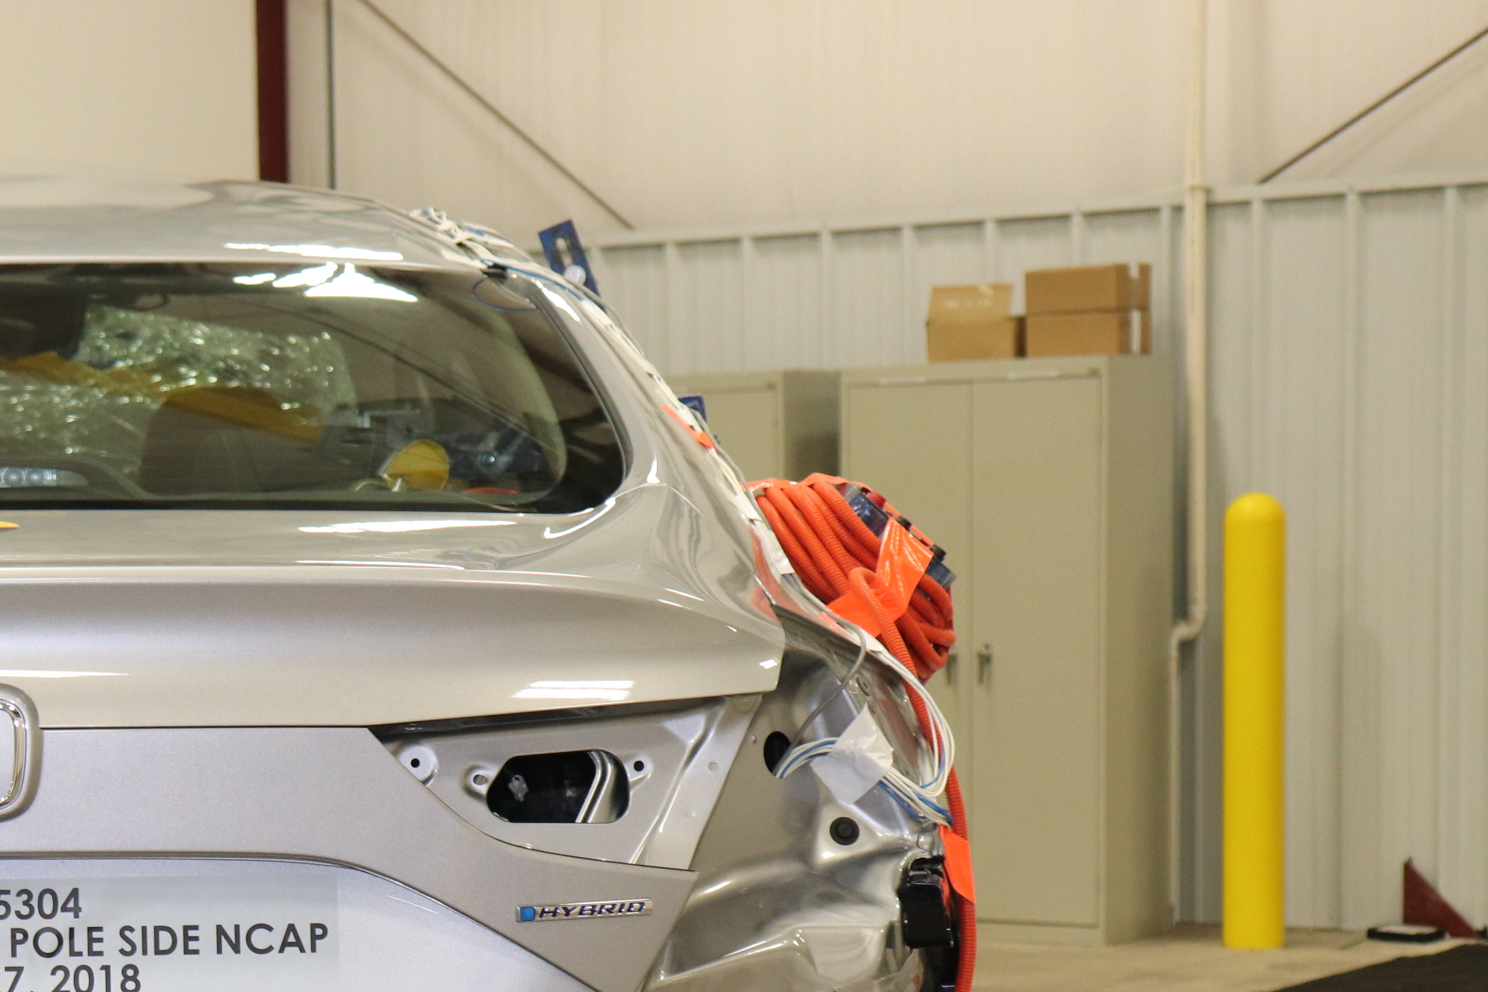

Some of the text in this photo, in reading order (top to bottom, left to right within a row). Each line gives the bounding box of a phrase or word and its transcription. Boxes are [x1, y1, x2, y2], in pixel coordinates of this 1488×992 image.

[538, 901, 646, 919] HYBRID
[11, 926, 104, 959] POLE
[118, 924, 200, 957] SIDE
[216, 922, 328, 955] NCAP
